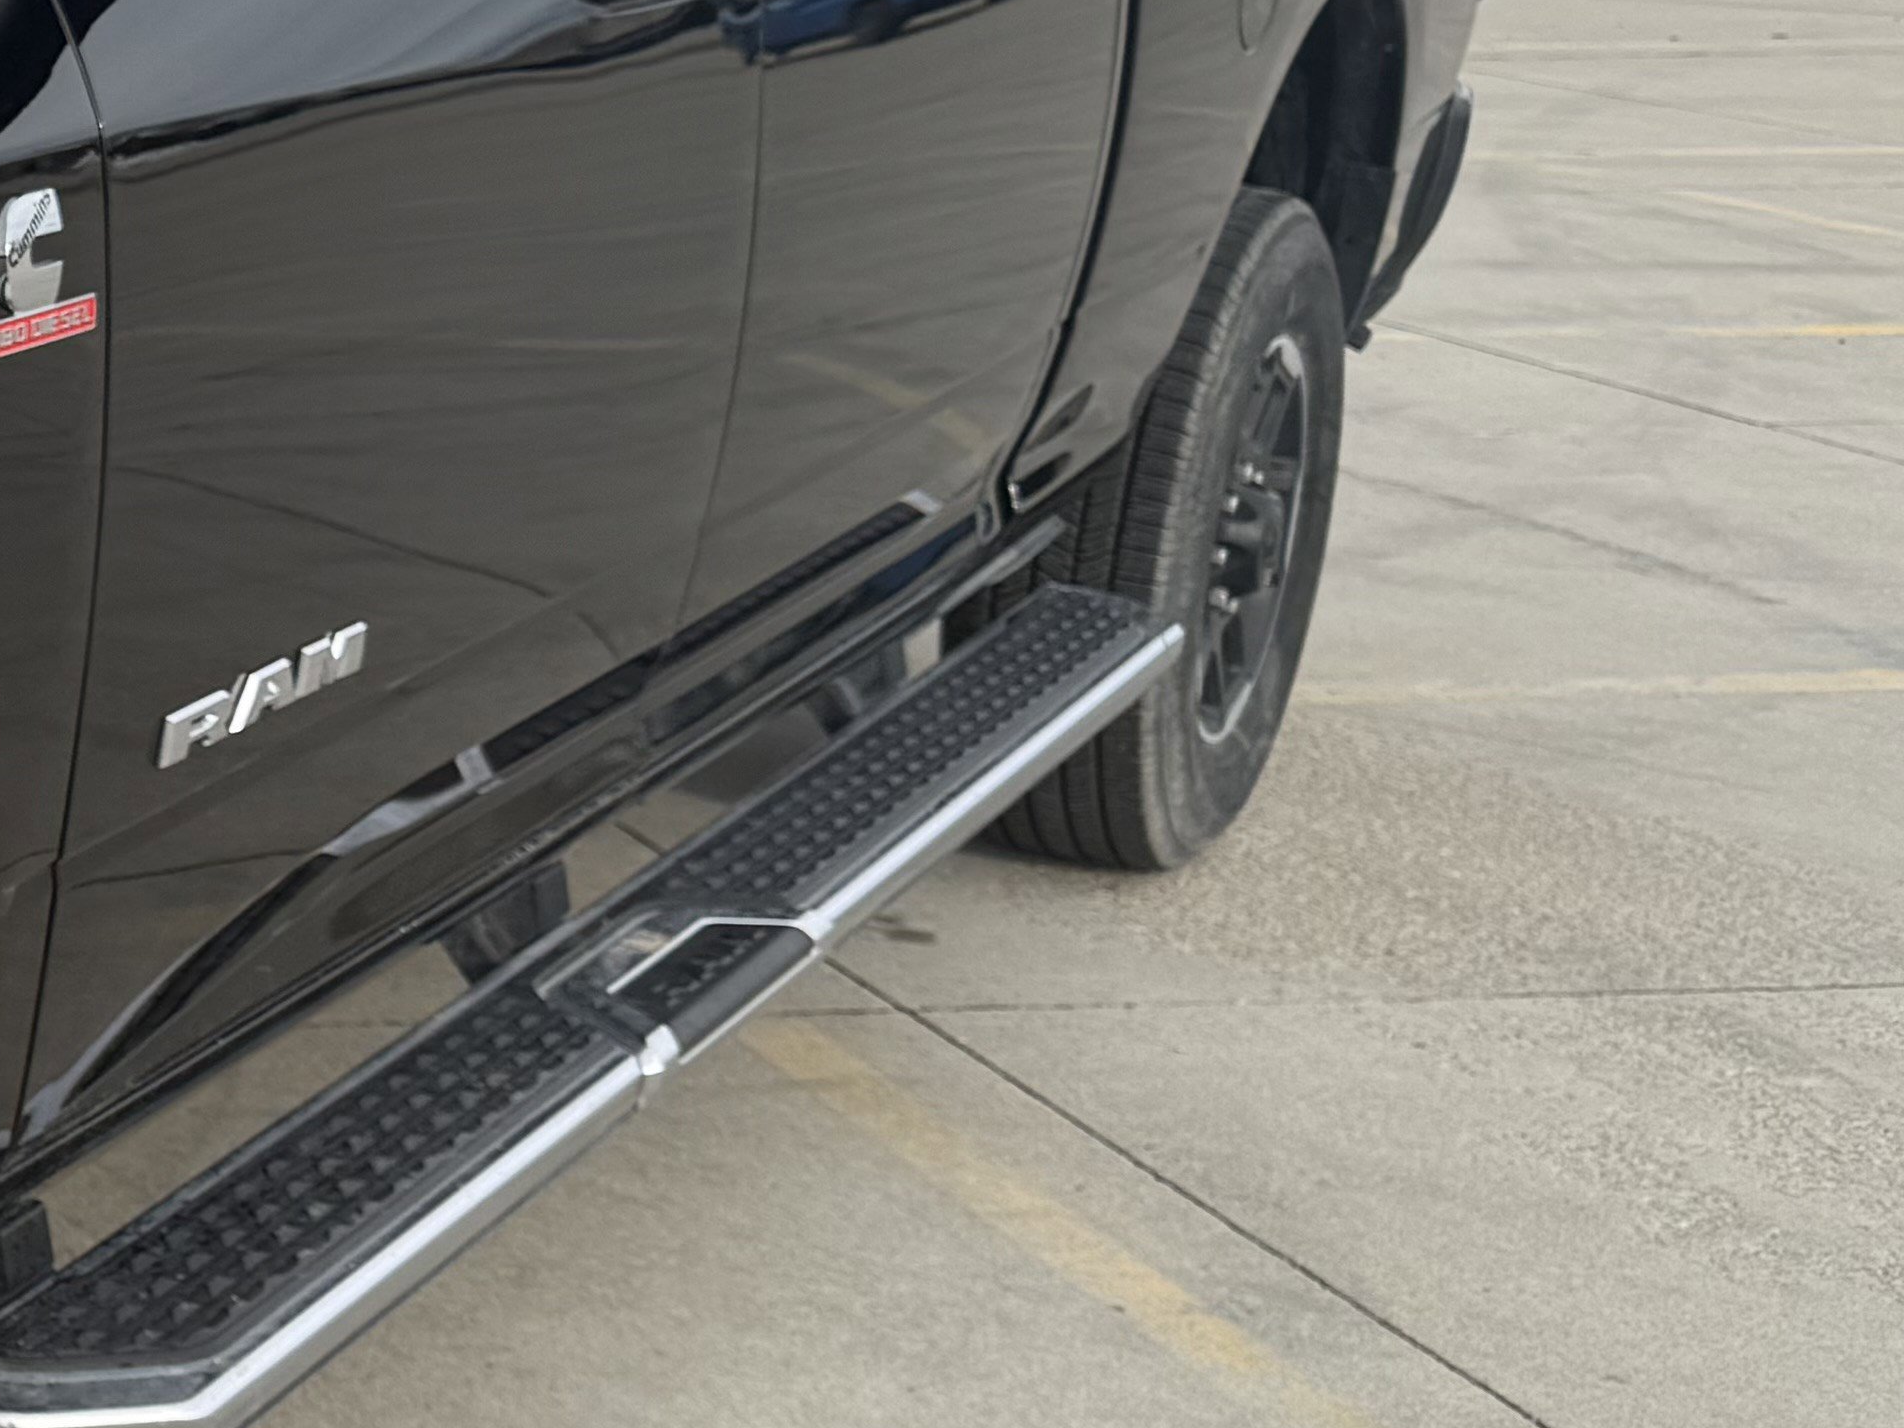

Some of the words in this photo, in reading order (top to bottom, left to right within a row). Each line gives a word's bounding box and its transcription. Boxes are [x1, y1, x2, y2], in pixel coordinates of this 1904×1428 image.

[7, 191, 53, 268] Cummins
[29, 304, 92, 338] DIESEL
[156, 619, 370, 771] RAM
